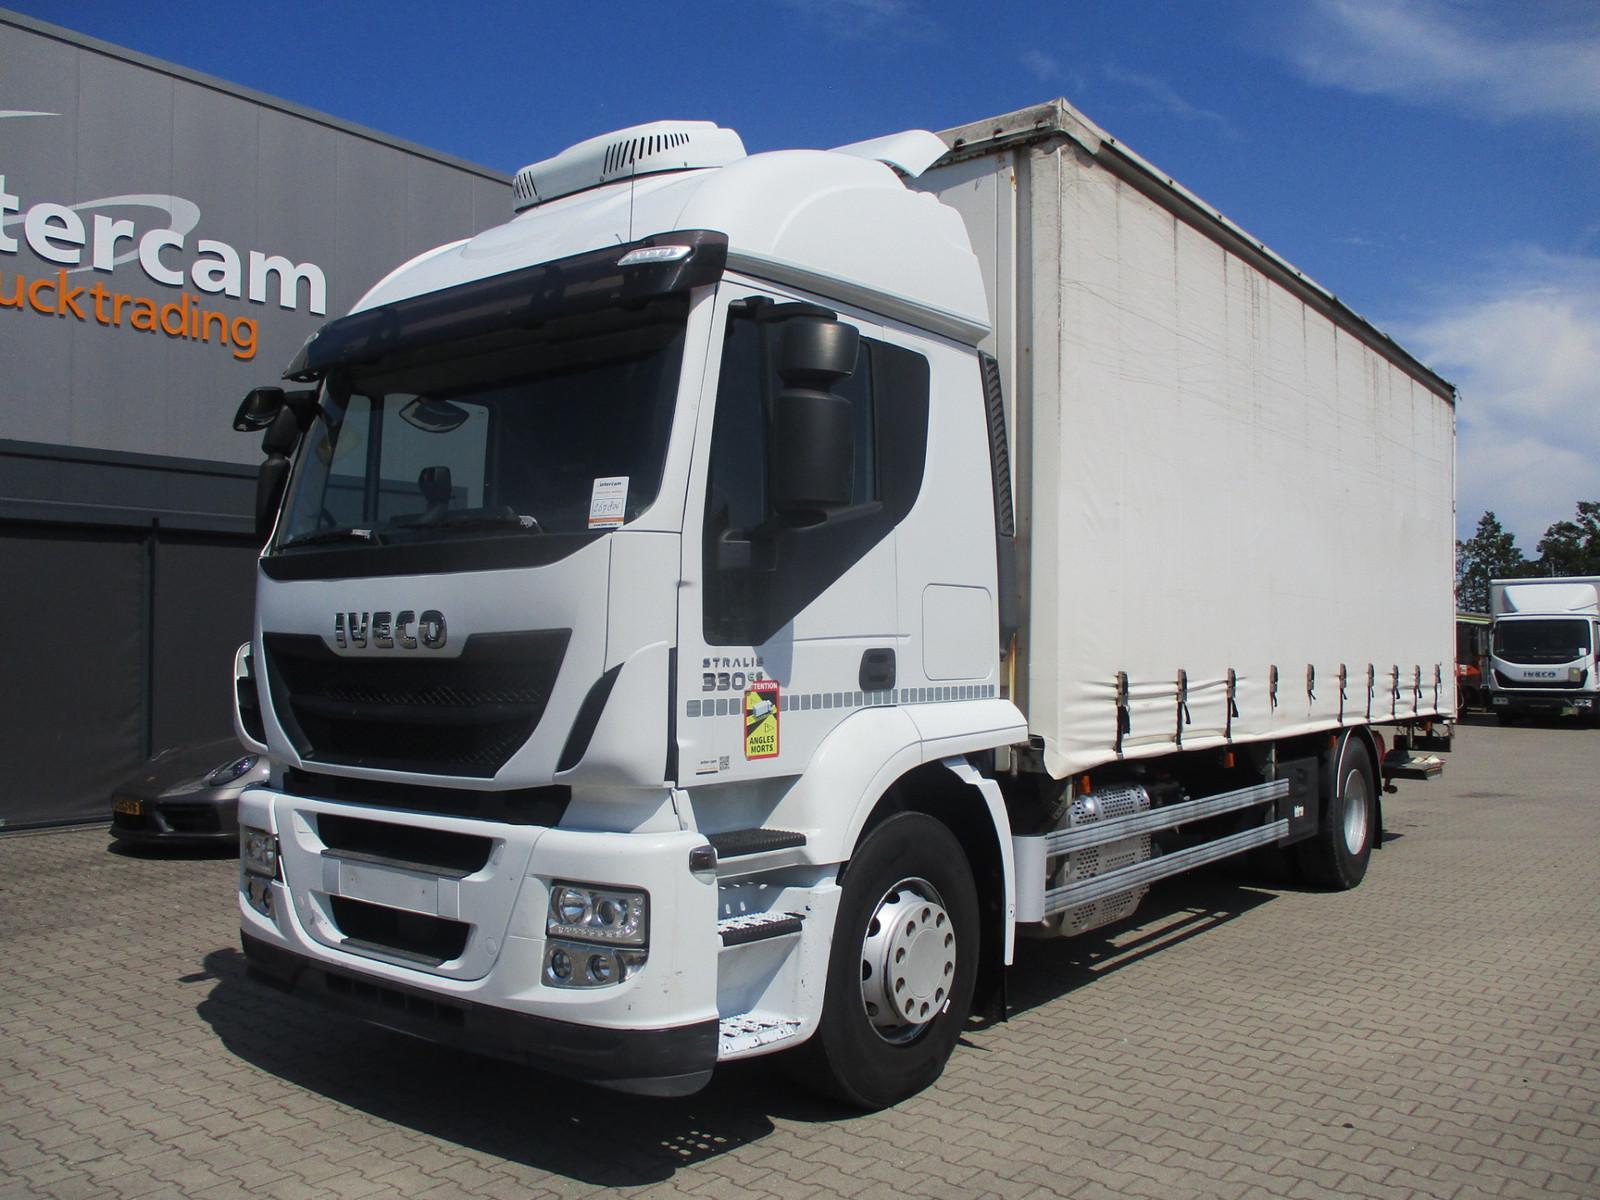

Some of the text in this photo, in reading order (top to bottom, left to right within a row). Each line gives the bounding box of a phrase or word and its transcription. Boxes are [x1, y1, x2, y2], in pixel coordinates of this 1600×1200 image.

[335, 610, 447, 649] IVECO
[702, 657, 764, 668] STRALIS
[702, 672, 746, 692] 330
[749, 735, 775, 745] ANGLES
[750, 744, 774, 754] MORTS
